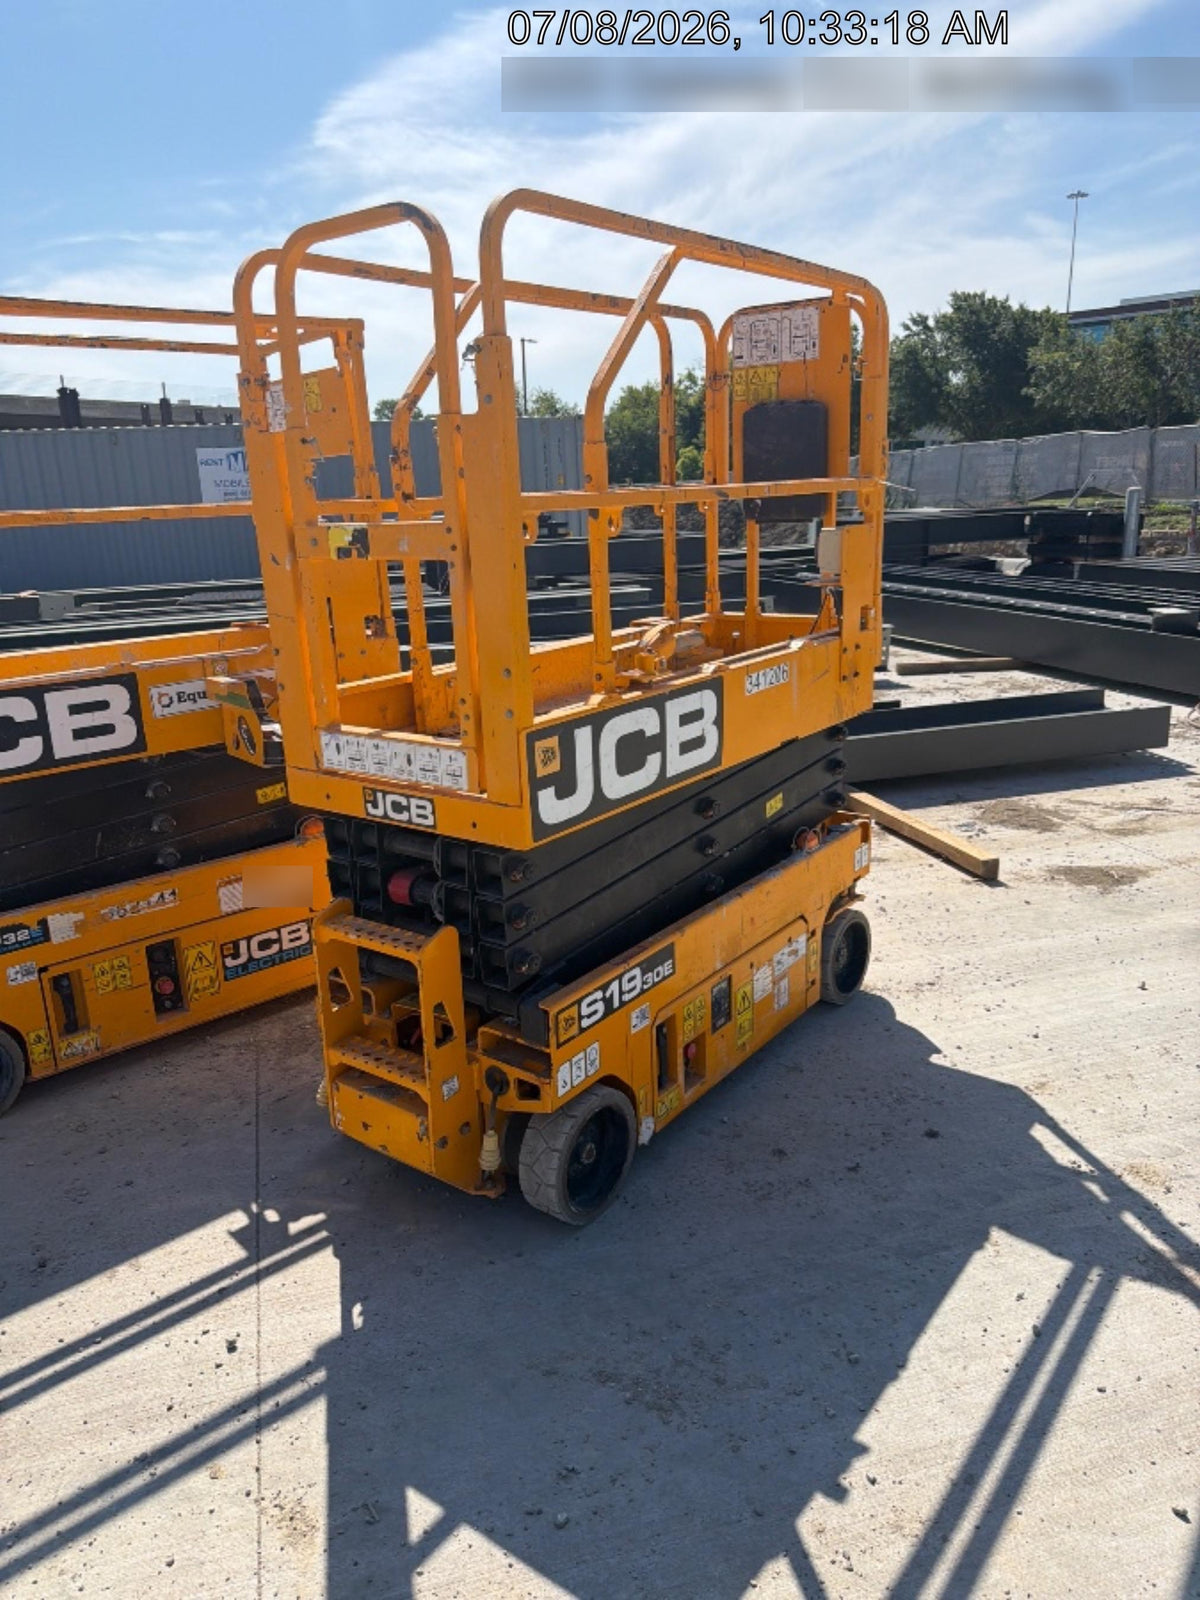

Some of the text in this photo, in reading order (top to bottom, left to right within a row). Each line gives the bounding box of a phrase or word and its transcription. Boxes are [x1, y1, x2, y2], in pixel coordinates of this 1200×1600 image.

[537, 688, 720, 825] JCB
[366, 791, 435, 827] JCB
[223, 921, 311, 968] JCB
[225, 944, 312, 981] ELECTRIC
